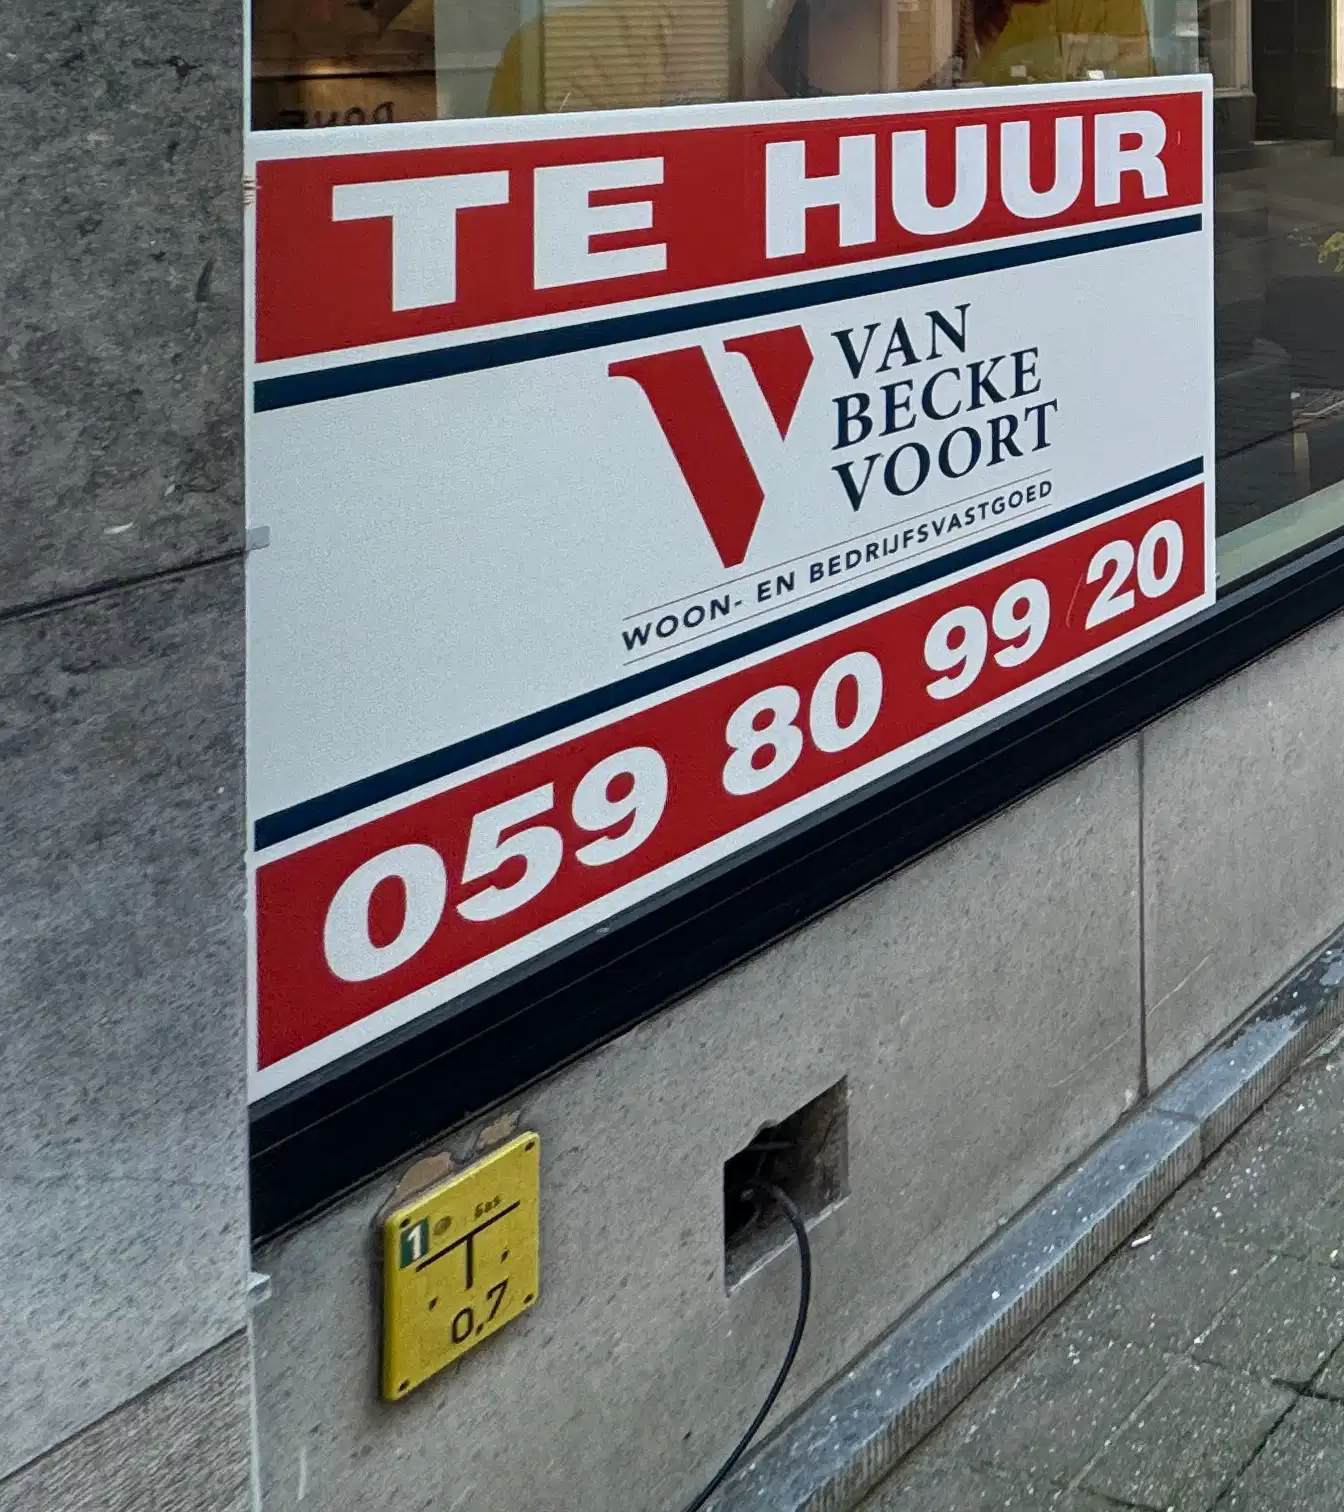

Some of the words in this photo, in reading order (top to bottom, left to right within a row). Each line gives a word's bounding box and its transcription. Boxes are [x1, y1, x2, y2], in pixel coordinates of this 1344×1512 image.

[332, 157, 667, 312] TE
[765, 110, 1169, 259] HUUR
[831, 302, 971, 380] VAN
[831, 346, 1042, 451] BECKE
[831, 398, 1058, 513] VOORT
[621, 593, 743, 651] WOON-
[757, 571, 795, 603] EN
[809, 480, 1053, 584] BEDRIJFSVASTGOED
[323, 746, 669, 982] 059
[722, 651, 883, 796] 80
[923, 578, 1051, 700] 99
[1084, 519, 1184, 630] 20
